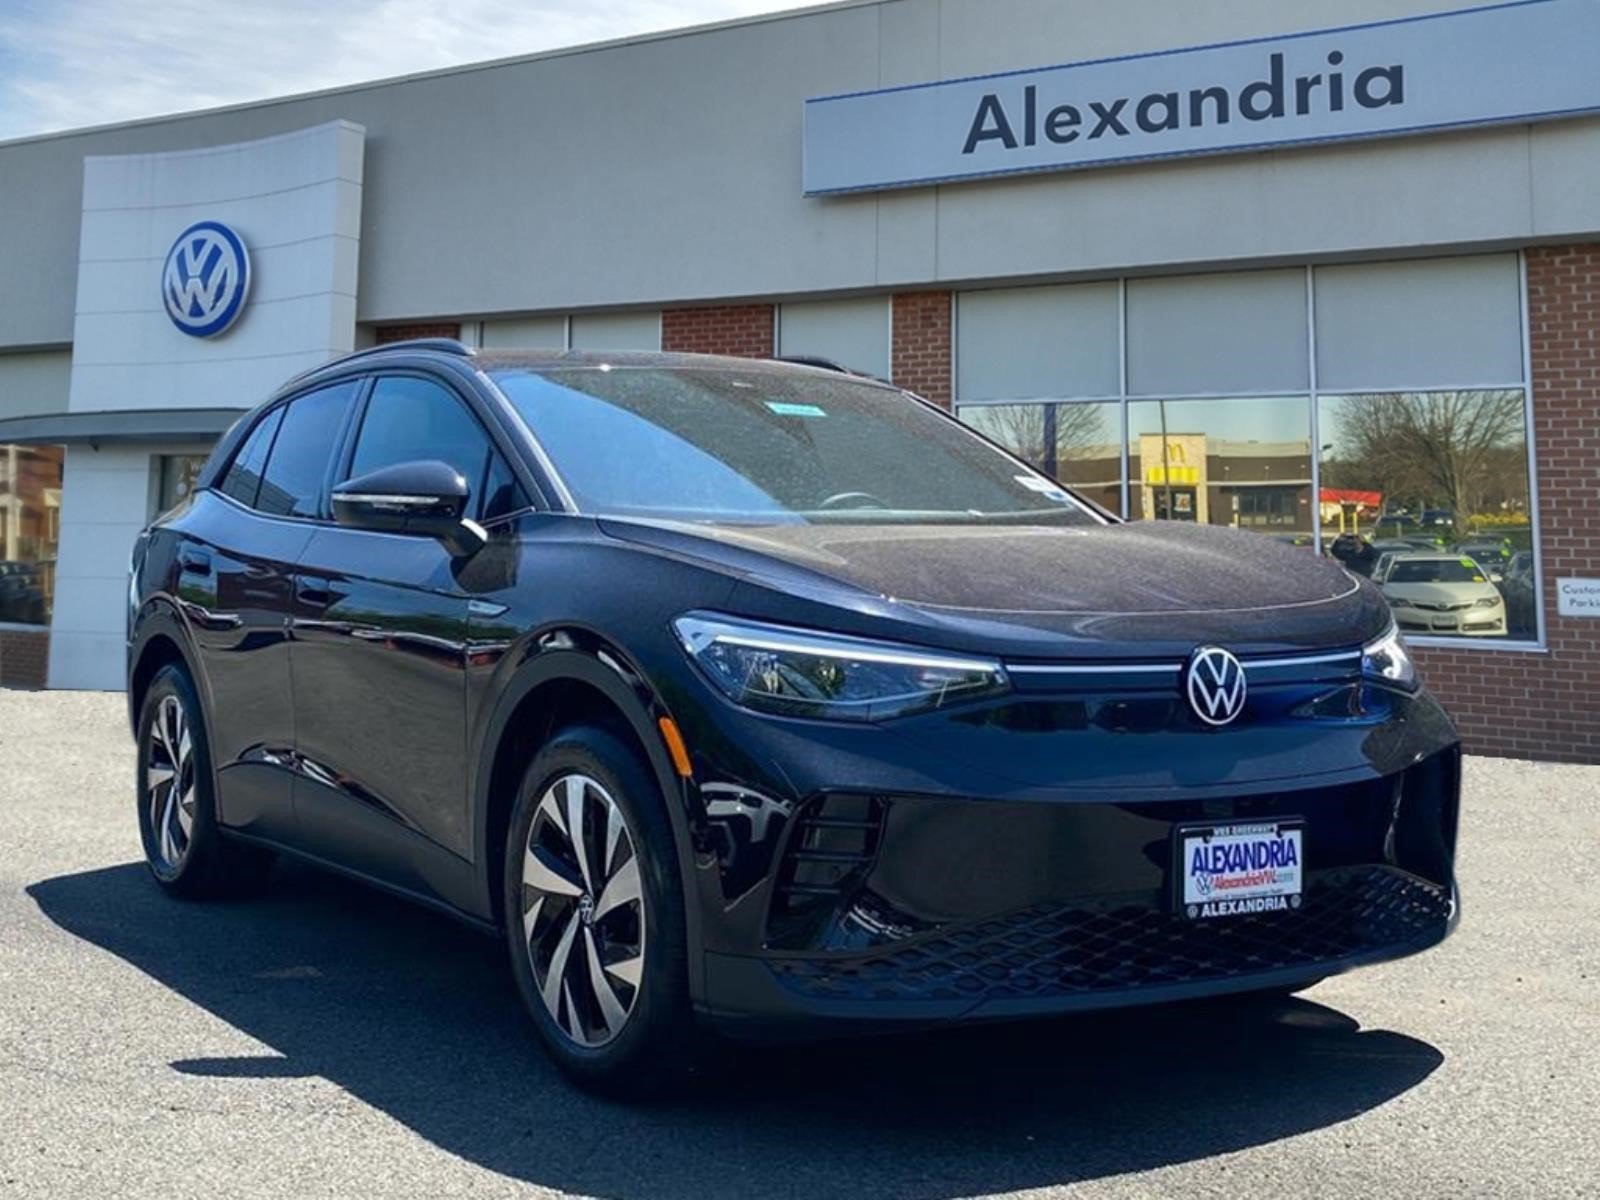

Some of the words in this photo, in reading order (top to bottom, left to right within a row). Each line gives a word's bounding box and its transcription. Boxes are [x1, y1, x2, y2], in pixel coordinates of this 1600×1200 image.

[962, 51, 1404, 154] Alexandria
[165, 230, 238, 326] VW
[1562, 584, 1600, 595] Custo
[1190, 650, 1244, 721] VW
[1190, 838, 1297, 876] ALEXANDRIA
[1201, 896, 1288, 917] ALEXANDRIA
